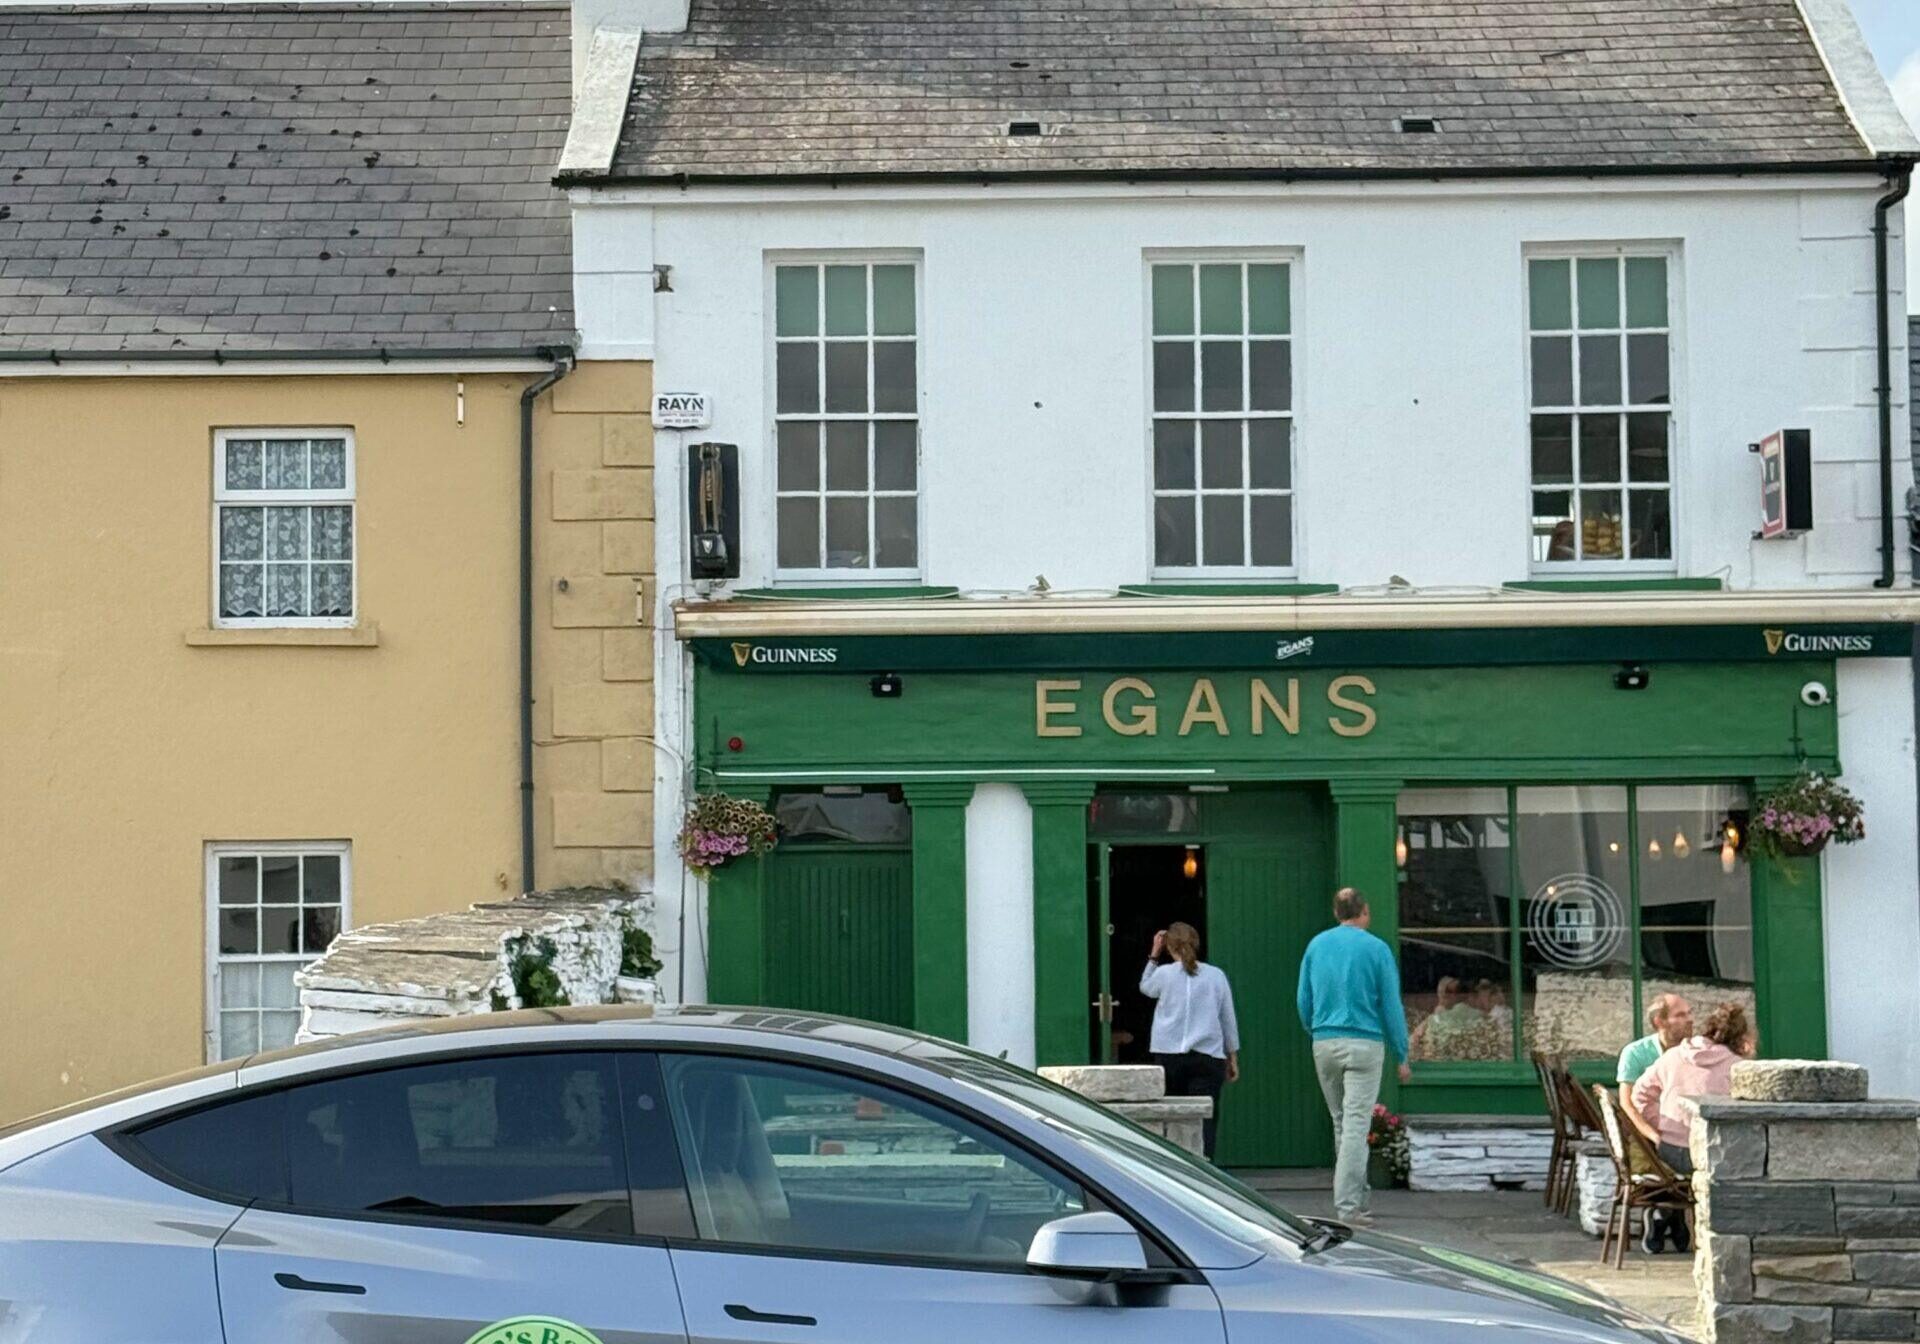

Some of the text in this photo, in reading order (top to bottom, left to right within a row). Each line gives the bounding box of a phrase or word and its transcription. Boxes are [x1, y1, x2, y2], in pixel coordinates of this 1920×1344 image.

[658, 397, 704, 410] RAYN
[1784, 633, 1873, 651] GUINNESS
[752, 646, 838, 663] GUINNESS
[1036, 675, 1377, 737] EGANS
